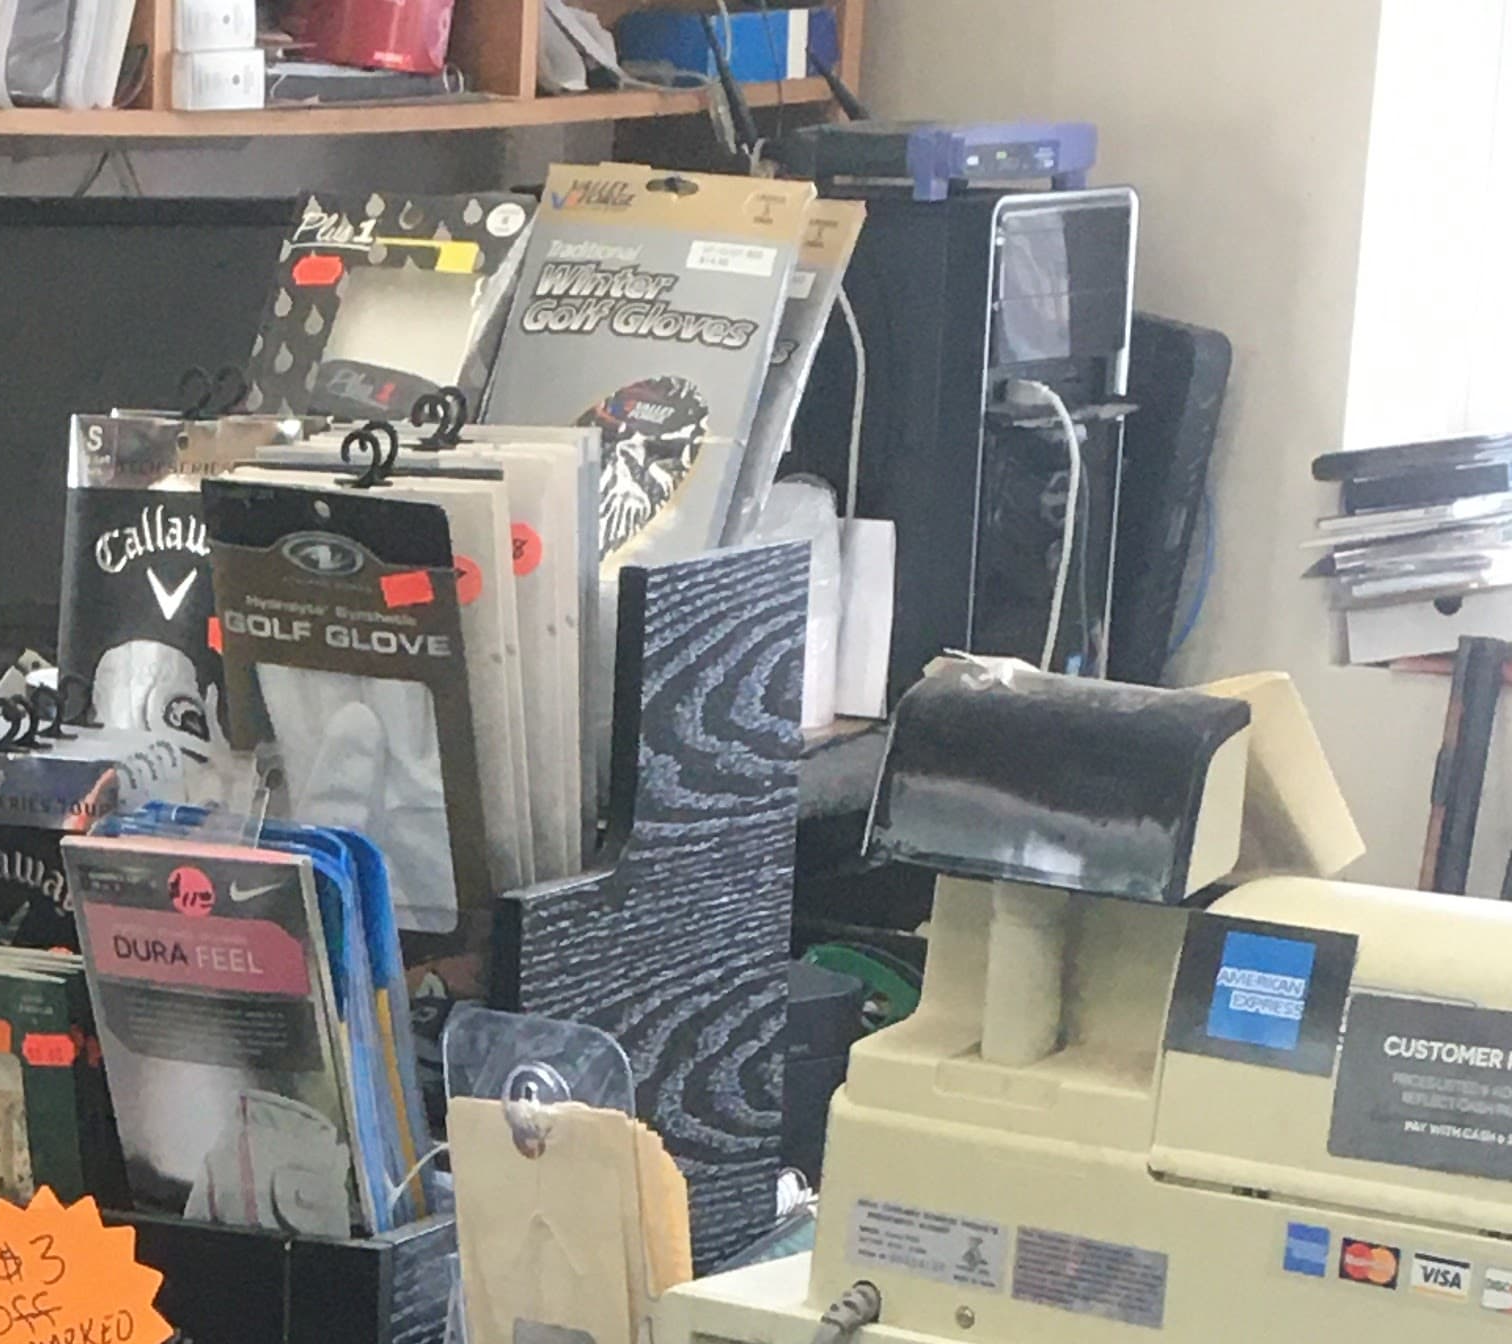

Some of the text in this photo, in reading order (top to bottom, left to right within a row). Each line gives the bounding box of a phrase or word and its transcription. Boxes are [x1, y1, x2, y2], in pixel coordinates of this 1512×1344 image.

[293, 212, 354, 243] Plus
[536, 262, 679, 301] Winter
[522, 298, 759, 350] Golf Gloves
[87, 425, 103, 451] S
[96, 504, 211, 574] Callaw
[223, 609, 452, 657] GOLF GLOVE
[113, 934, 265, 975] DURA FEEL
[1216, 966, 1306, 997] AMERICAN
[1229, 990, 1306, 1020] EXPRESS
[1383, 1035, 1502, 1069] CUSTOMER
[1404, 1119, 1428, 1132] PAY
[1420, 1264, 1462, 1290] VISA
